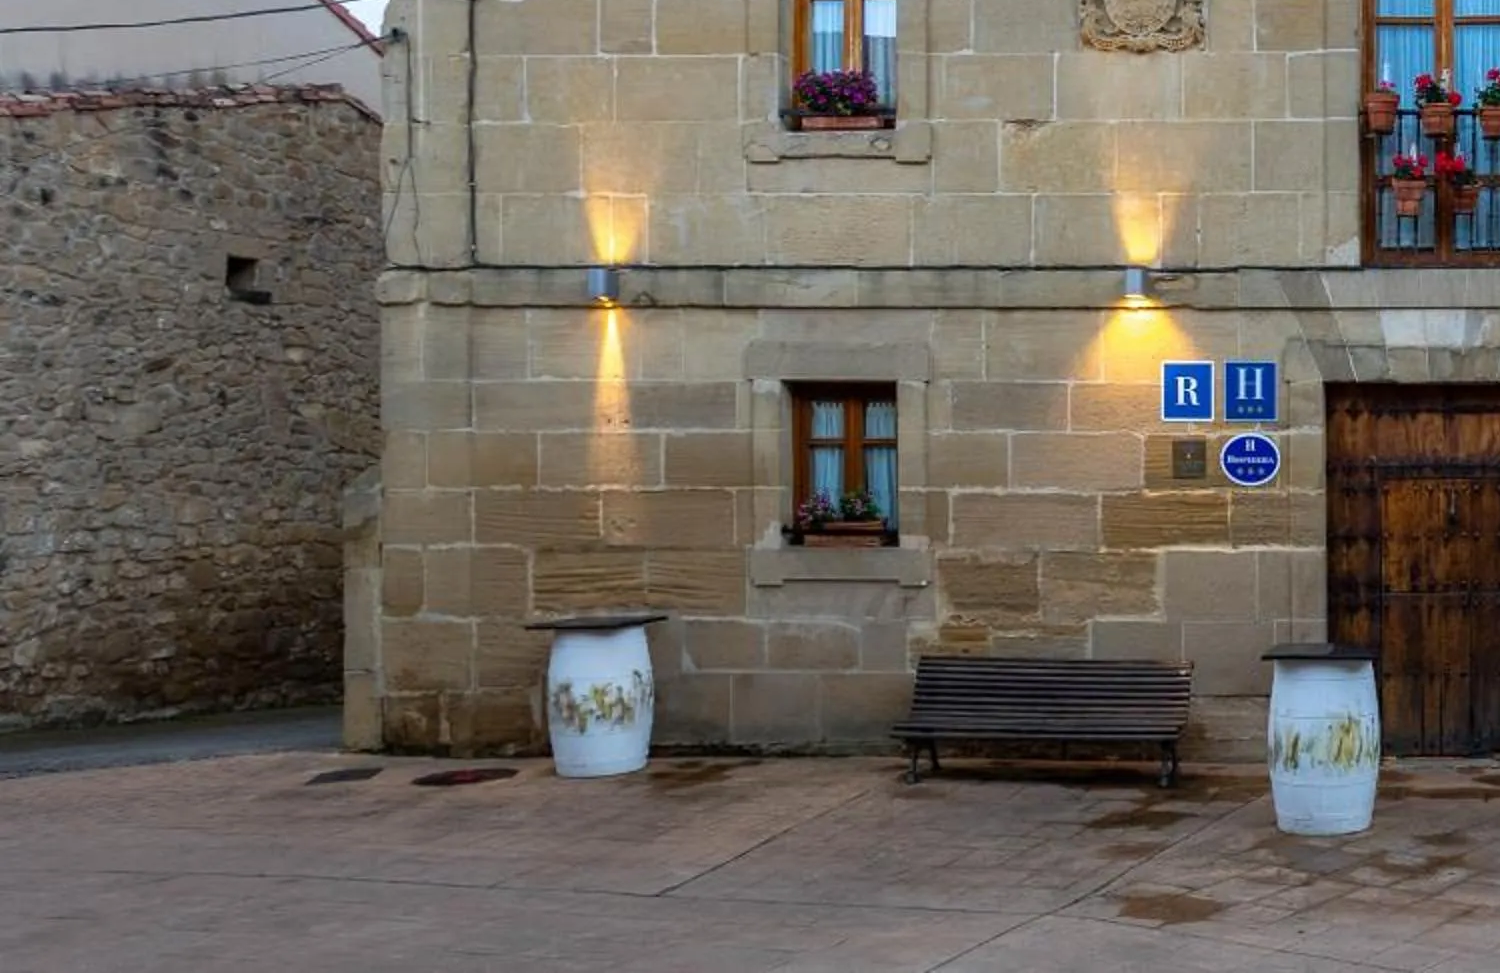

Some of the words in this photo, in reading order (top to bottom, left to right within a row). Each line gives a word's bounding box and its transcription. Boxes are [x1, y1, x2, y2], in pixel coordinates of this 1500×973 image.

[1174, 375, 1200, 406] R
[1235, 367, 1265, 400] H
[1244, 439, 1256, 452] H
